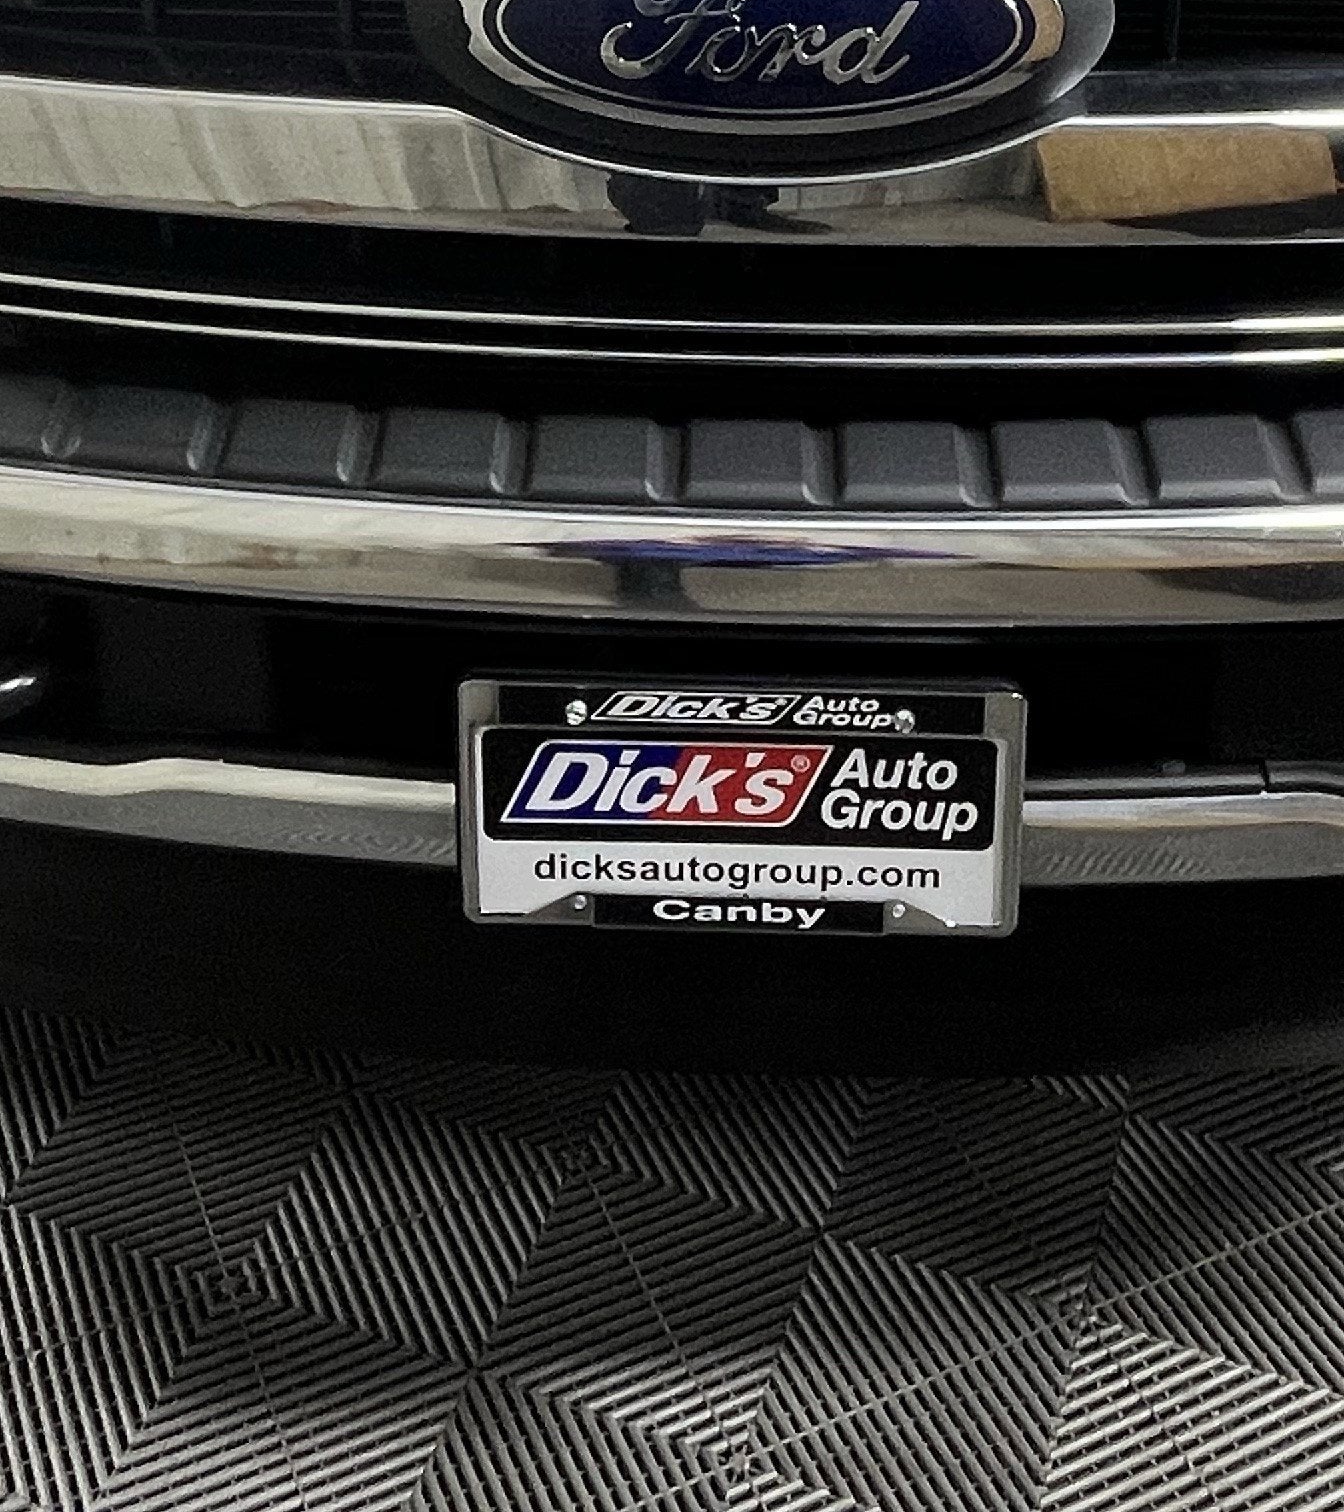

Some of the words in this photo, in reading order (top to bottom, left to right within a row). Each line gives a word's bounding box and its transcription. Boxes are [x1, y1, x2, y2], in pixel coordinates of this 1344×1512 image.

[792, 710, 897, 730] Group
[800, 694, 880, 713] Auto
[831, 748, 958, 790] Auto
[820, 790, 978, 841] Group
[533, 852, 942, 889] dicksautogroup.com
[652, 899, 826, 928] Canby
